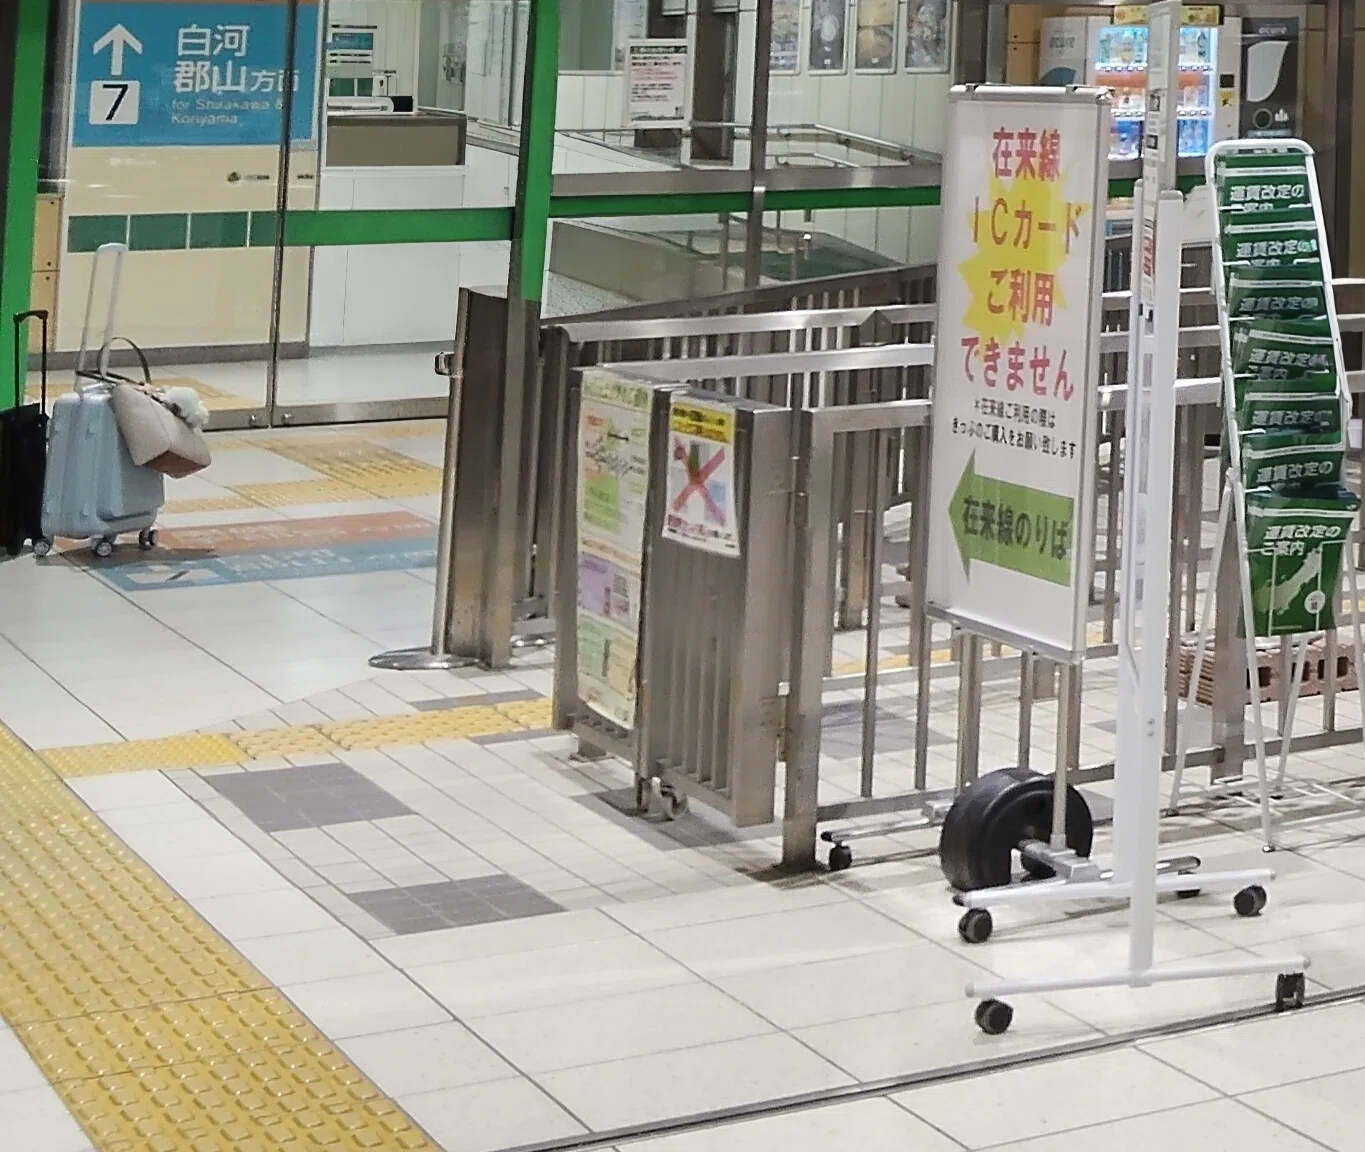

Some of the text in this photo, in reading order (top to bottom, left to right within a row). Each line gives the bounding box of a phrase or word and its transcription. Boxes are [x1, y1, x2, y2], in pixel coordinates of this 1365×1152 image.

[178, 23, 250, 57] 白河
[101, 84, 129, 121] 7
[992, 126, 1062, 183] 在来線
[1230, 184, 1305, 202] 運賃改定の
[971, 195, 1084, 256] ICカード
[986, 268, 1056, 327] ご利用
[961, 336, 1074, 402] できません
[962, 494, 1070, 561] 在来線のりば
